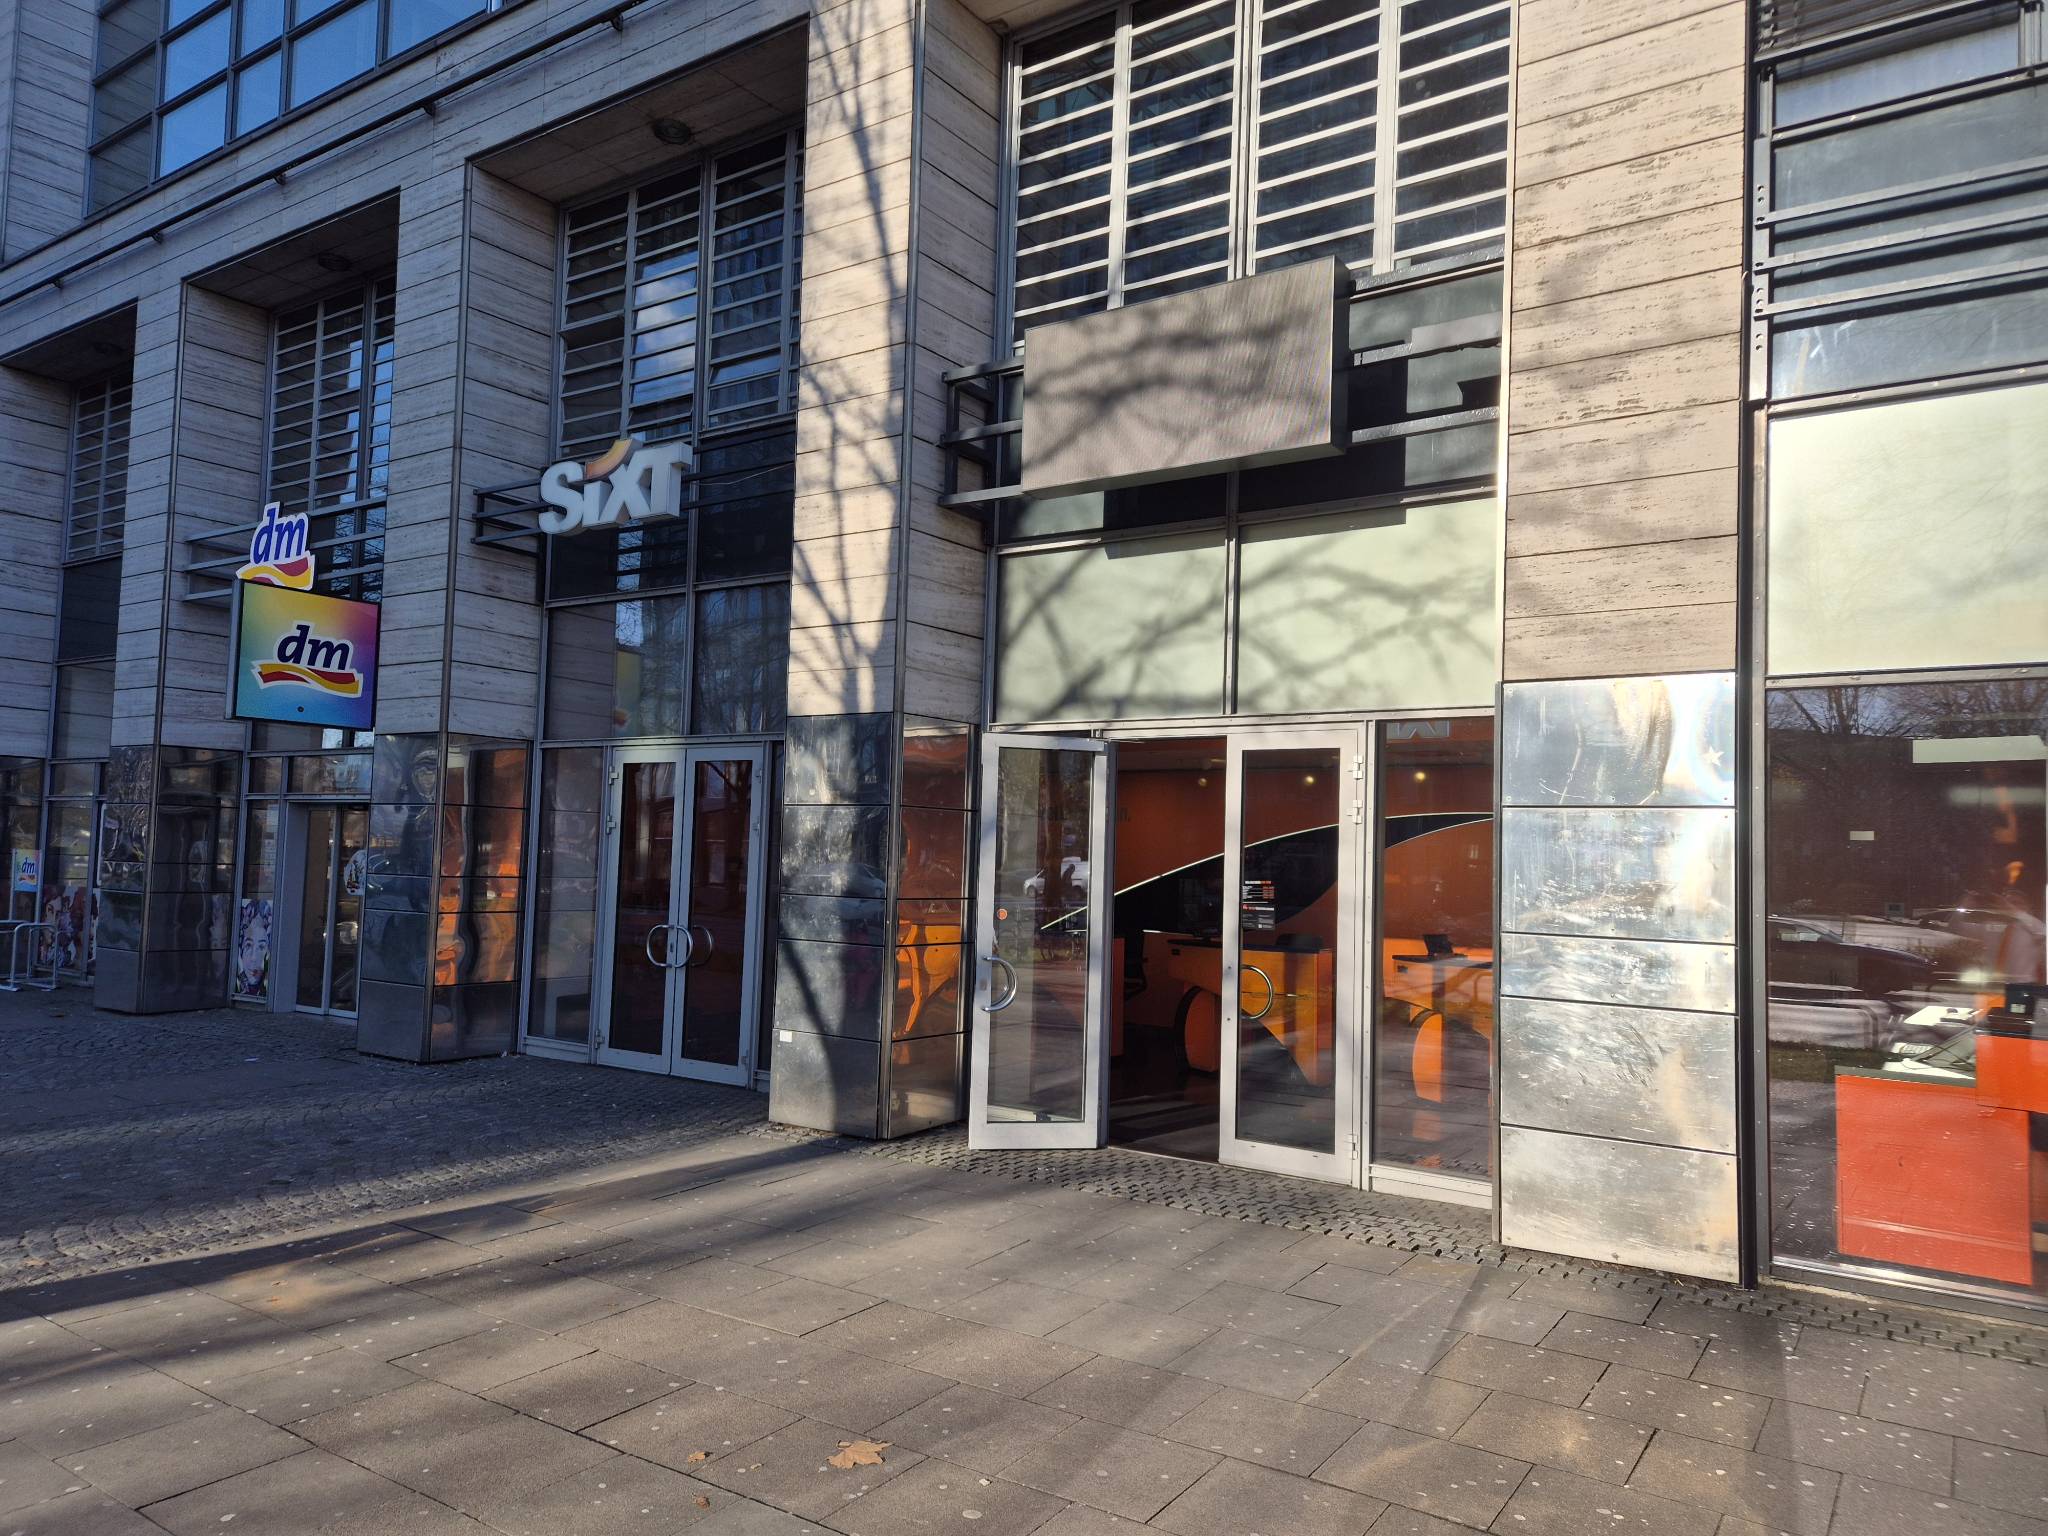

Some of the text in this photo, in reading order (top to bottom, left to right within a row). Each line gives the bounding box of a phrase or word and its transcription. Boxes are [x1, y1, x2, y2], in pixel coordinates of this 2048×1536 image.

[253, 507, 305, 564] dm
[277, 624, 351, 671] dm
[21, 857, 35, 873] dm
